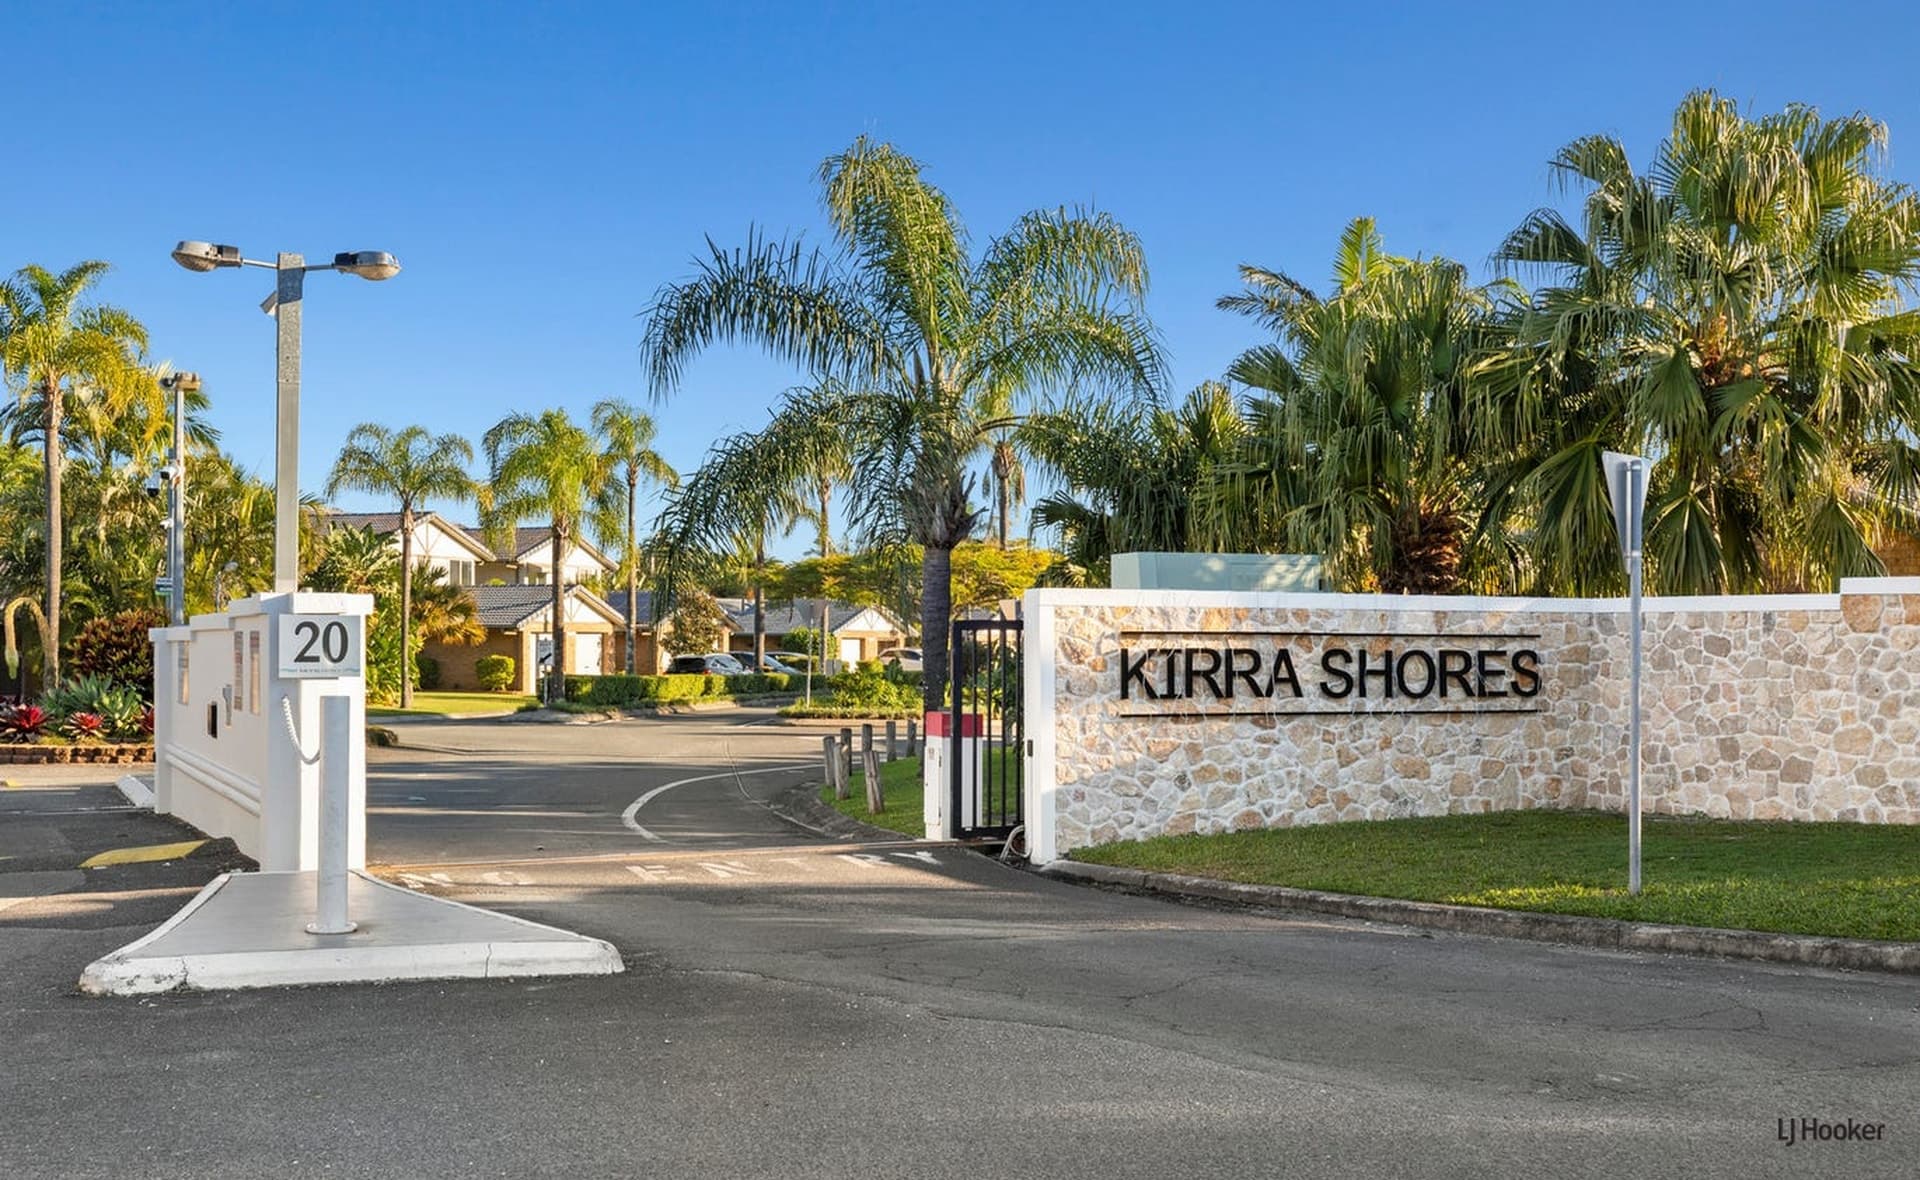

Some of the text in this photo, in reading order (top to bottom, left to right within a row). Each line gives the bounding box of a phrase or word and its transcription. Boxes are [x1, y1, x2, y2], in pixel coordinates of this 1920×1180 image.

[294, 621, 349, 664] 20
[1120, 648, 1542, 700] KIRRA SHORES
[625, 851, 943, 881] ENTRY
